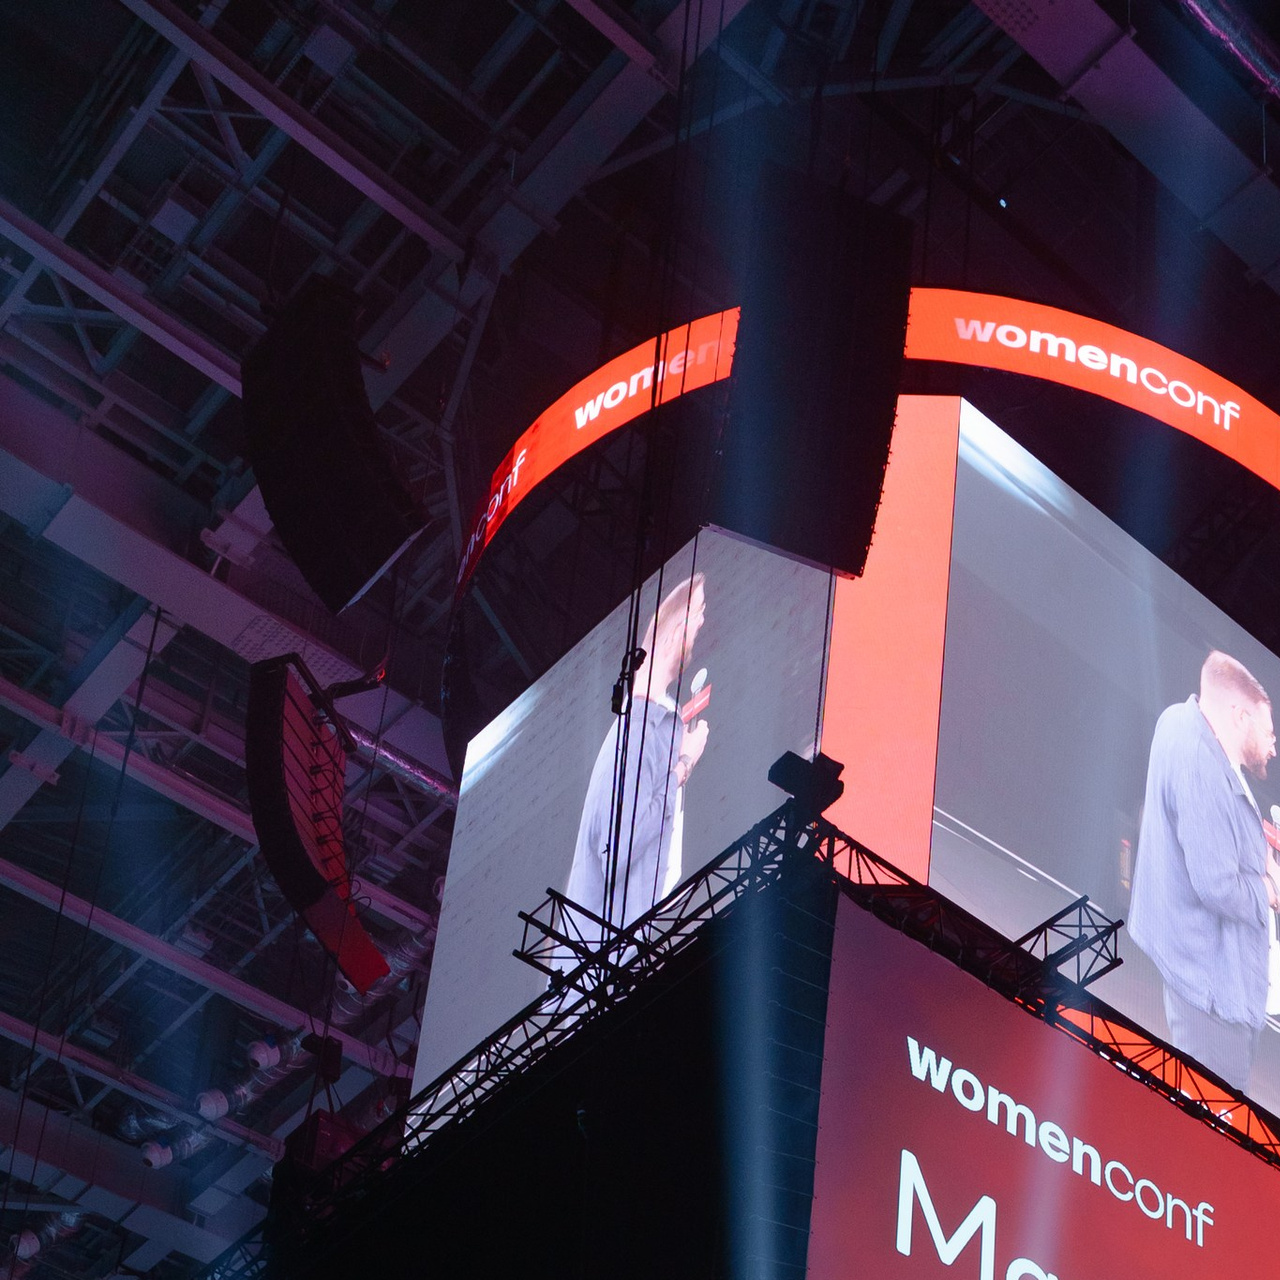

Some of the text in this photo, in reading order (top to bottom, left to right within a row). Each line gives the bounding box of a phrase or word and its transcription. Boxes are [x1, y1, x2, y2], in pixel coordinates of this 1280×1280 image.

[574, 339, 723, 430] women
[954, 317, 1241, 431] womenconf
[907, 1035, 1215, 1248] womenconf
